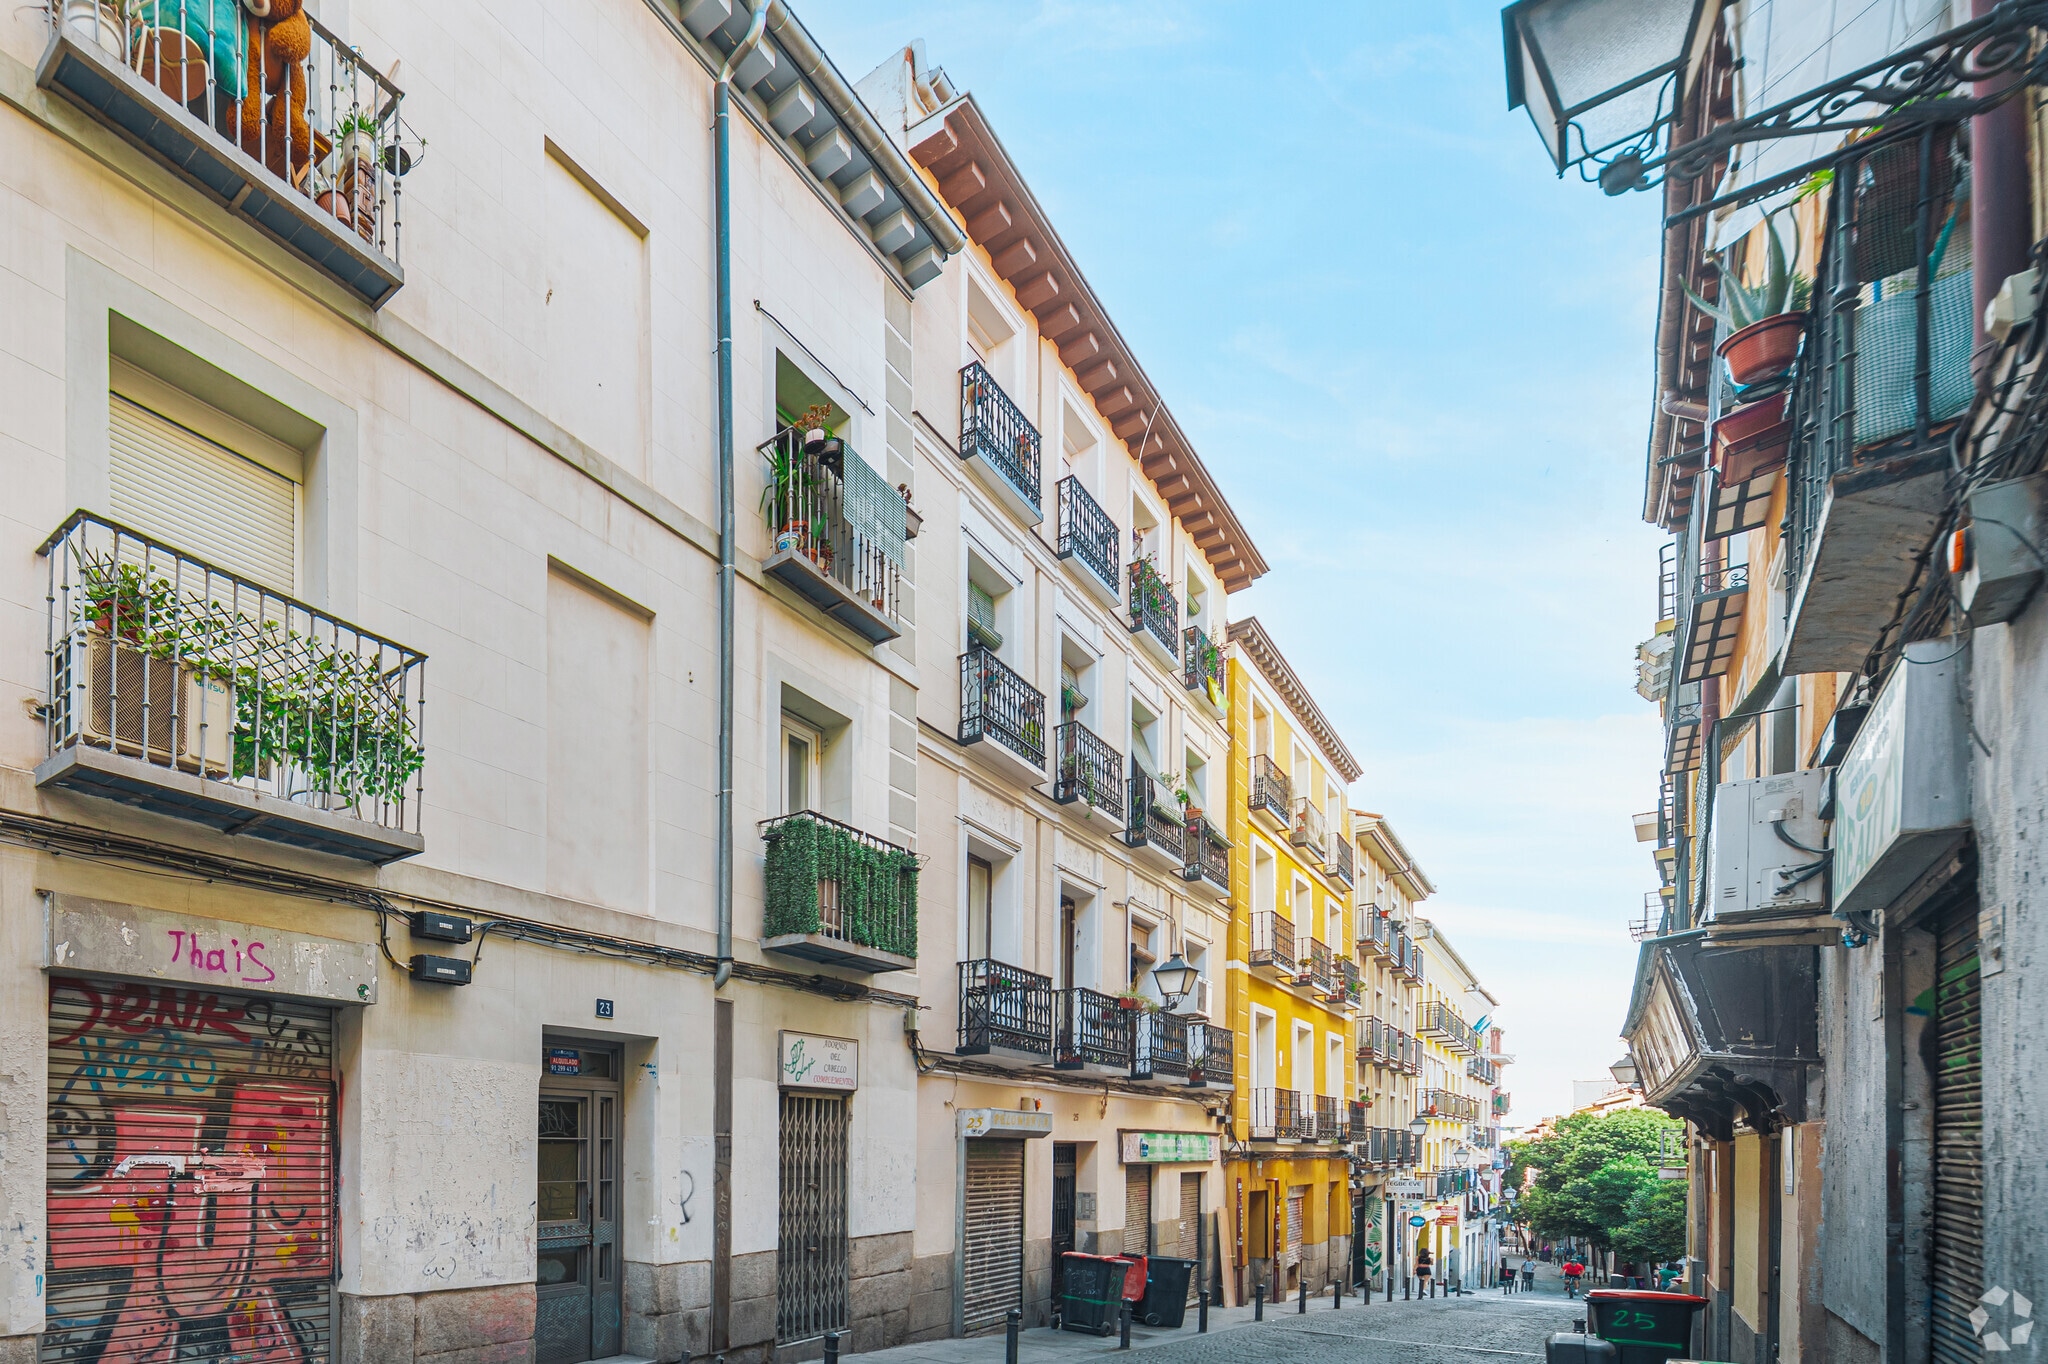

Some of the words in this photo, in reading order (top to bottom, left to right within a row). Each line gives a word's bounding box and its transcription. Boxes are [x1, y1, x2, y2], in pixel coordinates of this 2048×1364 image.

[599, 1002, 611, 1015] 23
[823, 1040, 848, 1051] ADORNOS
[552, 1057, 578, 1065] ALQUILADO
[830, 1052, 841, 1061] DEL
[823, 1063, 848, 1073] CABELLO
[813, 1075, 855, 1086] COMPLEMENTOS
[966, 1116, 983, 1129] 25
[1073, 1113, 1079, 1121] 25
[1612, 1310, 1656, 1330] 25
